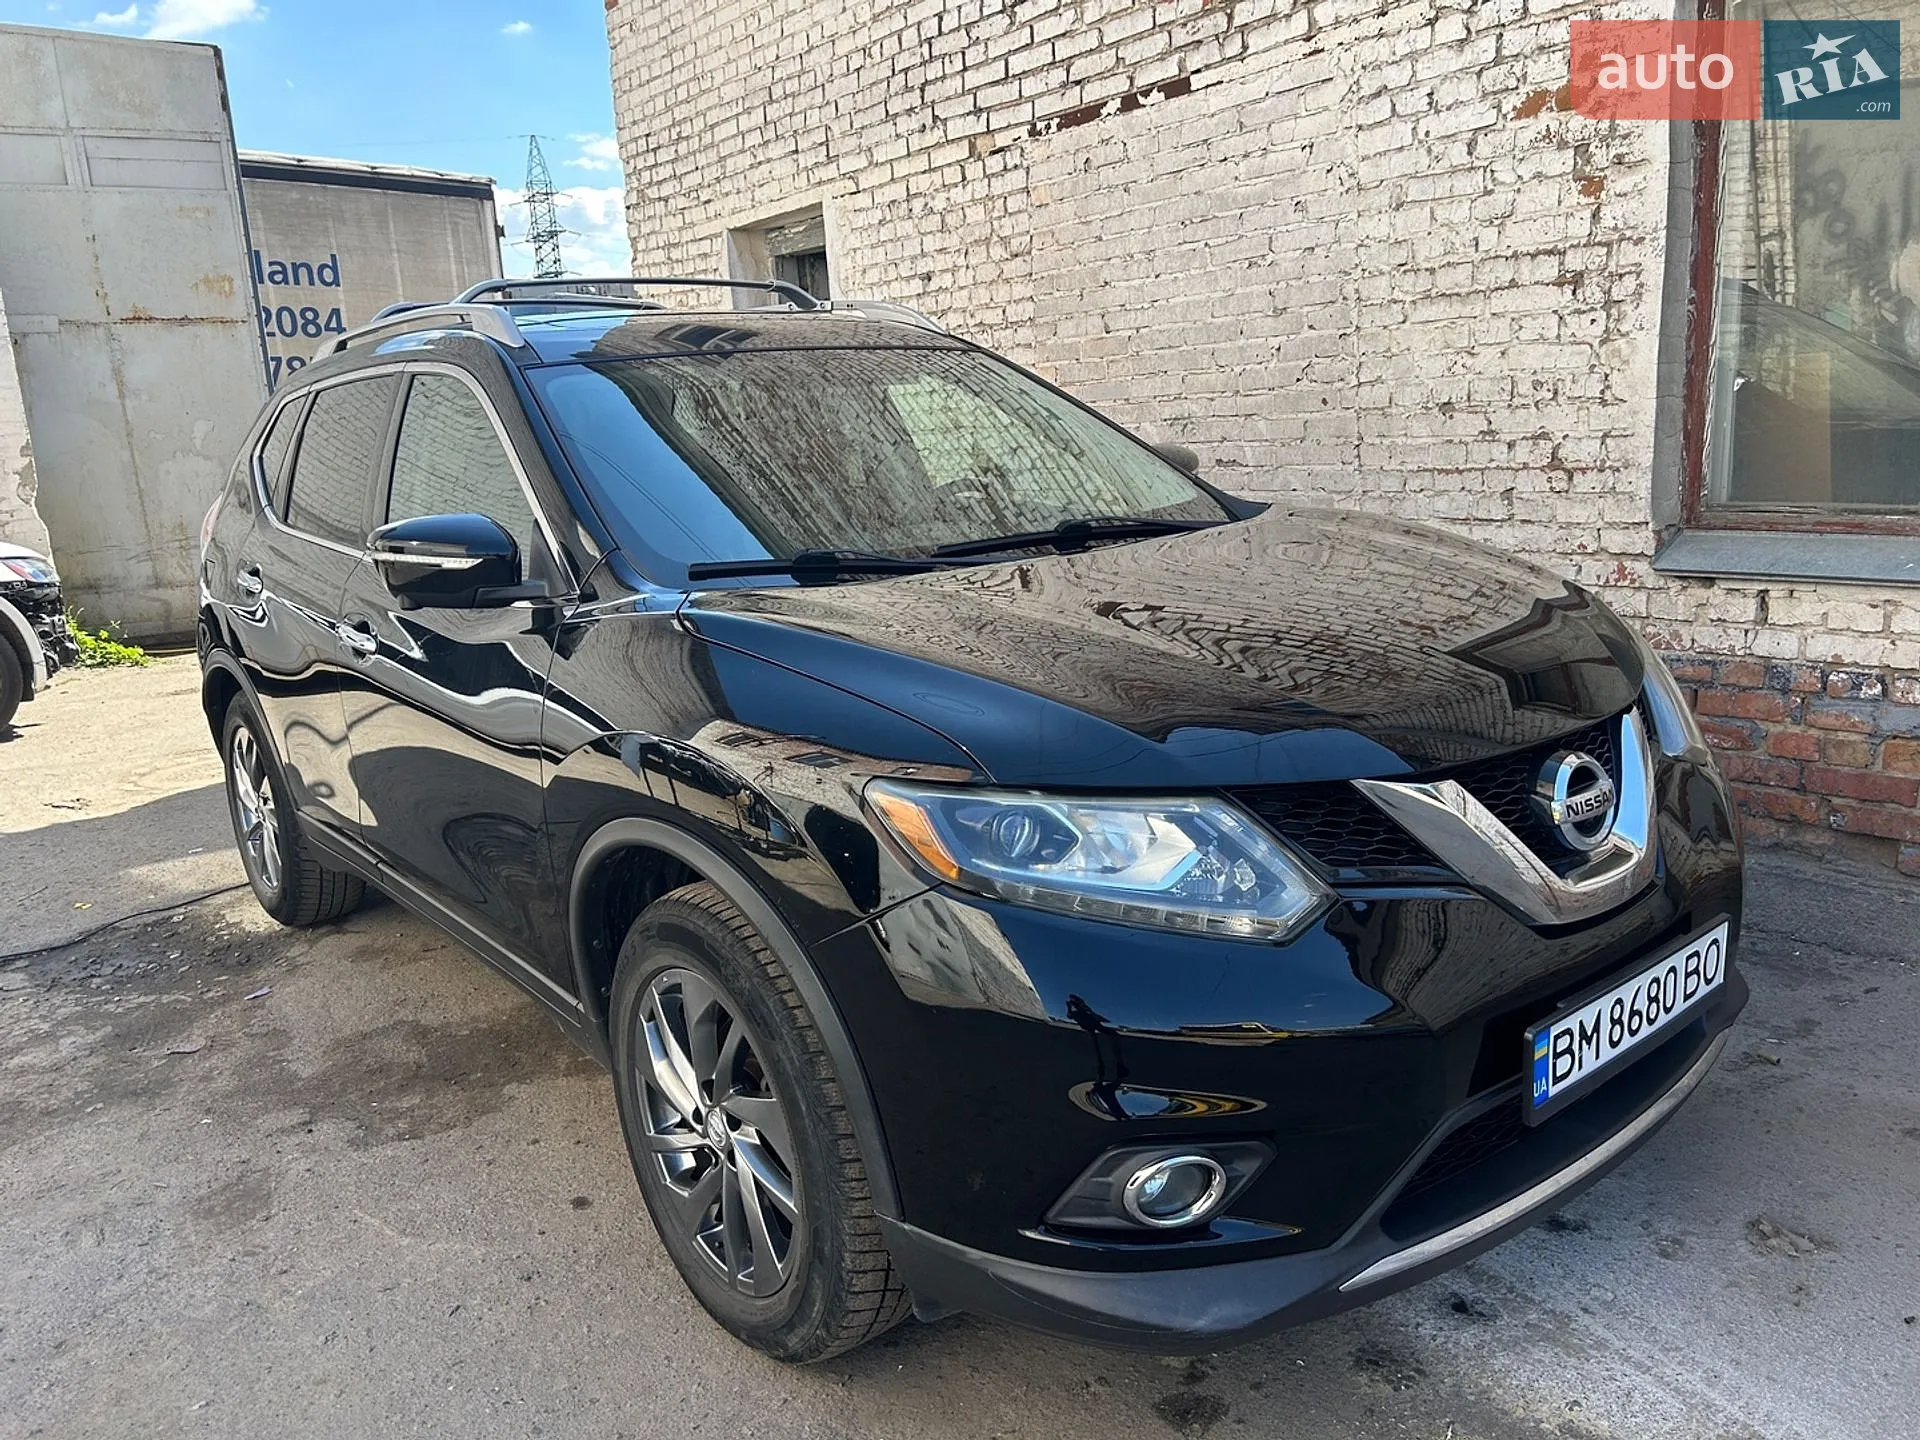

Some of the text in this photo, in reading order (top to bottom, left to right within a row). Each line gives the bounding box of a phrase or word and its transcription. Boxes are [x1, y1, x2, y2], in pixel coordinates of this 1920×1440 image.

[1551, 937, 1721, 1087] BM 8680 BO
[1533, 1077, 1548, 1098] UA
